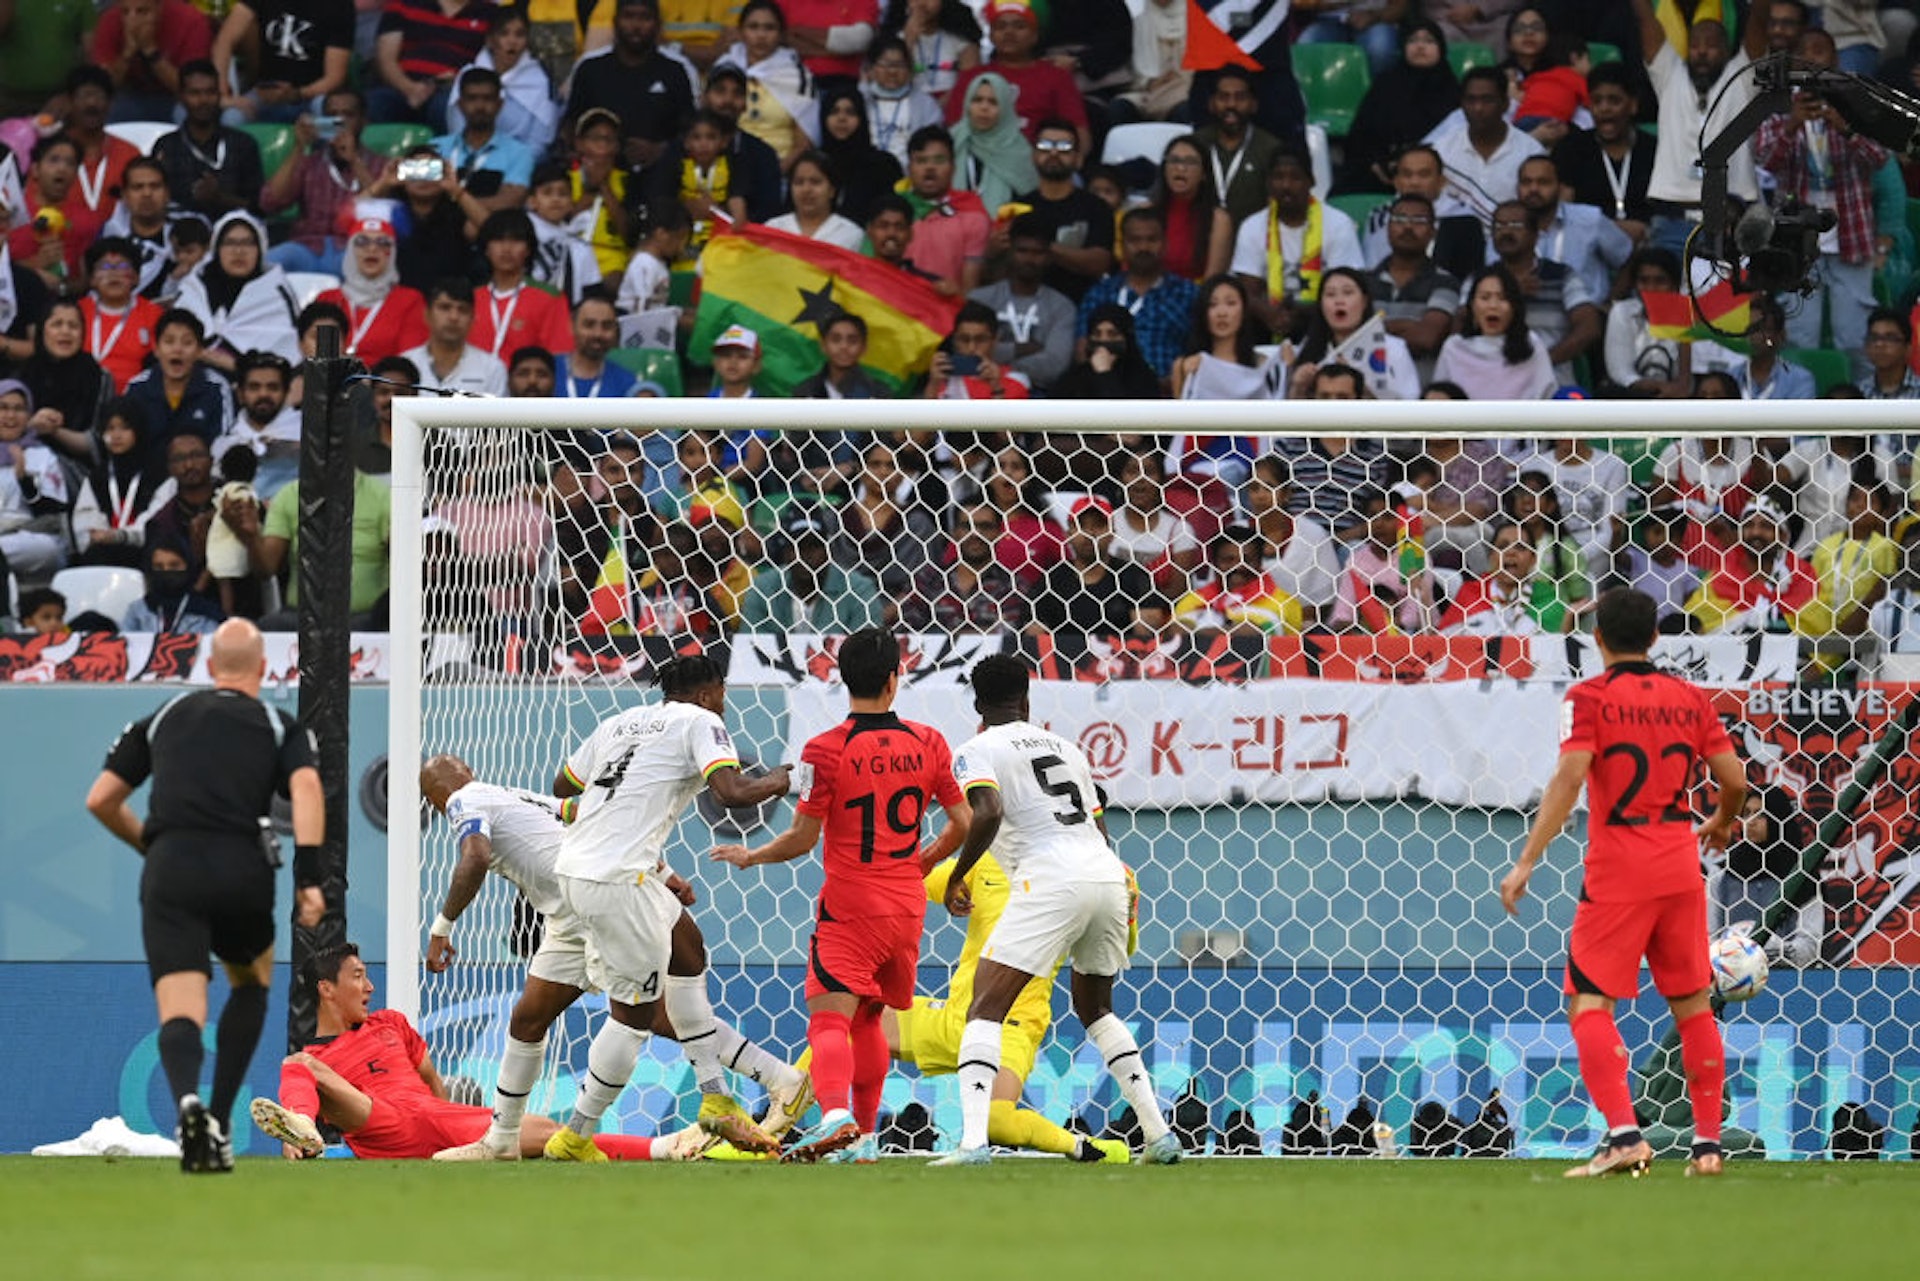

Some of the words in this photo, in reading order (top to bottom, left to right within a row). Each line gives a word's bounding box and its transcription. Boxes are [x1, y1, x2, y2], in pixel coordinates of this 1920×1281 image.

[594, 742, 641, 802] 4
[852, 757, 863, 776] Y
[870, 755, 885, 775] G
[890, 753, 923, 772] KIM
[1031, 754, 1088, 826] 5
[1602, 741, 1693, 826] 22
[844, 785, 925, 864] 19
[643, 970, 659, 997] 4
